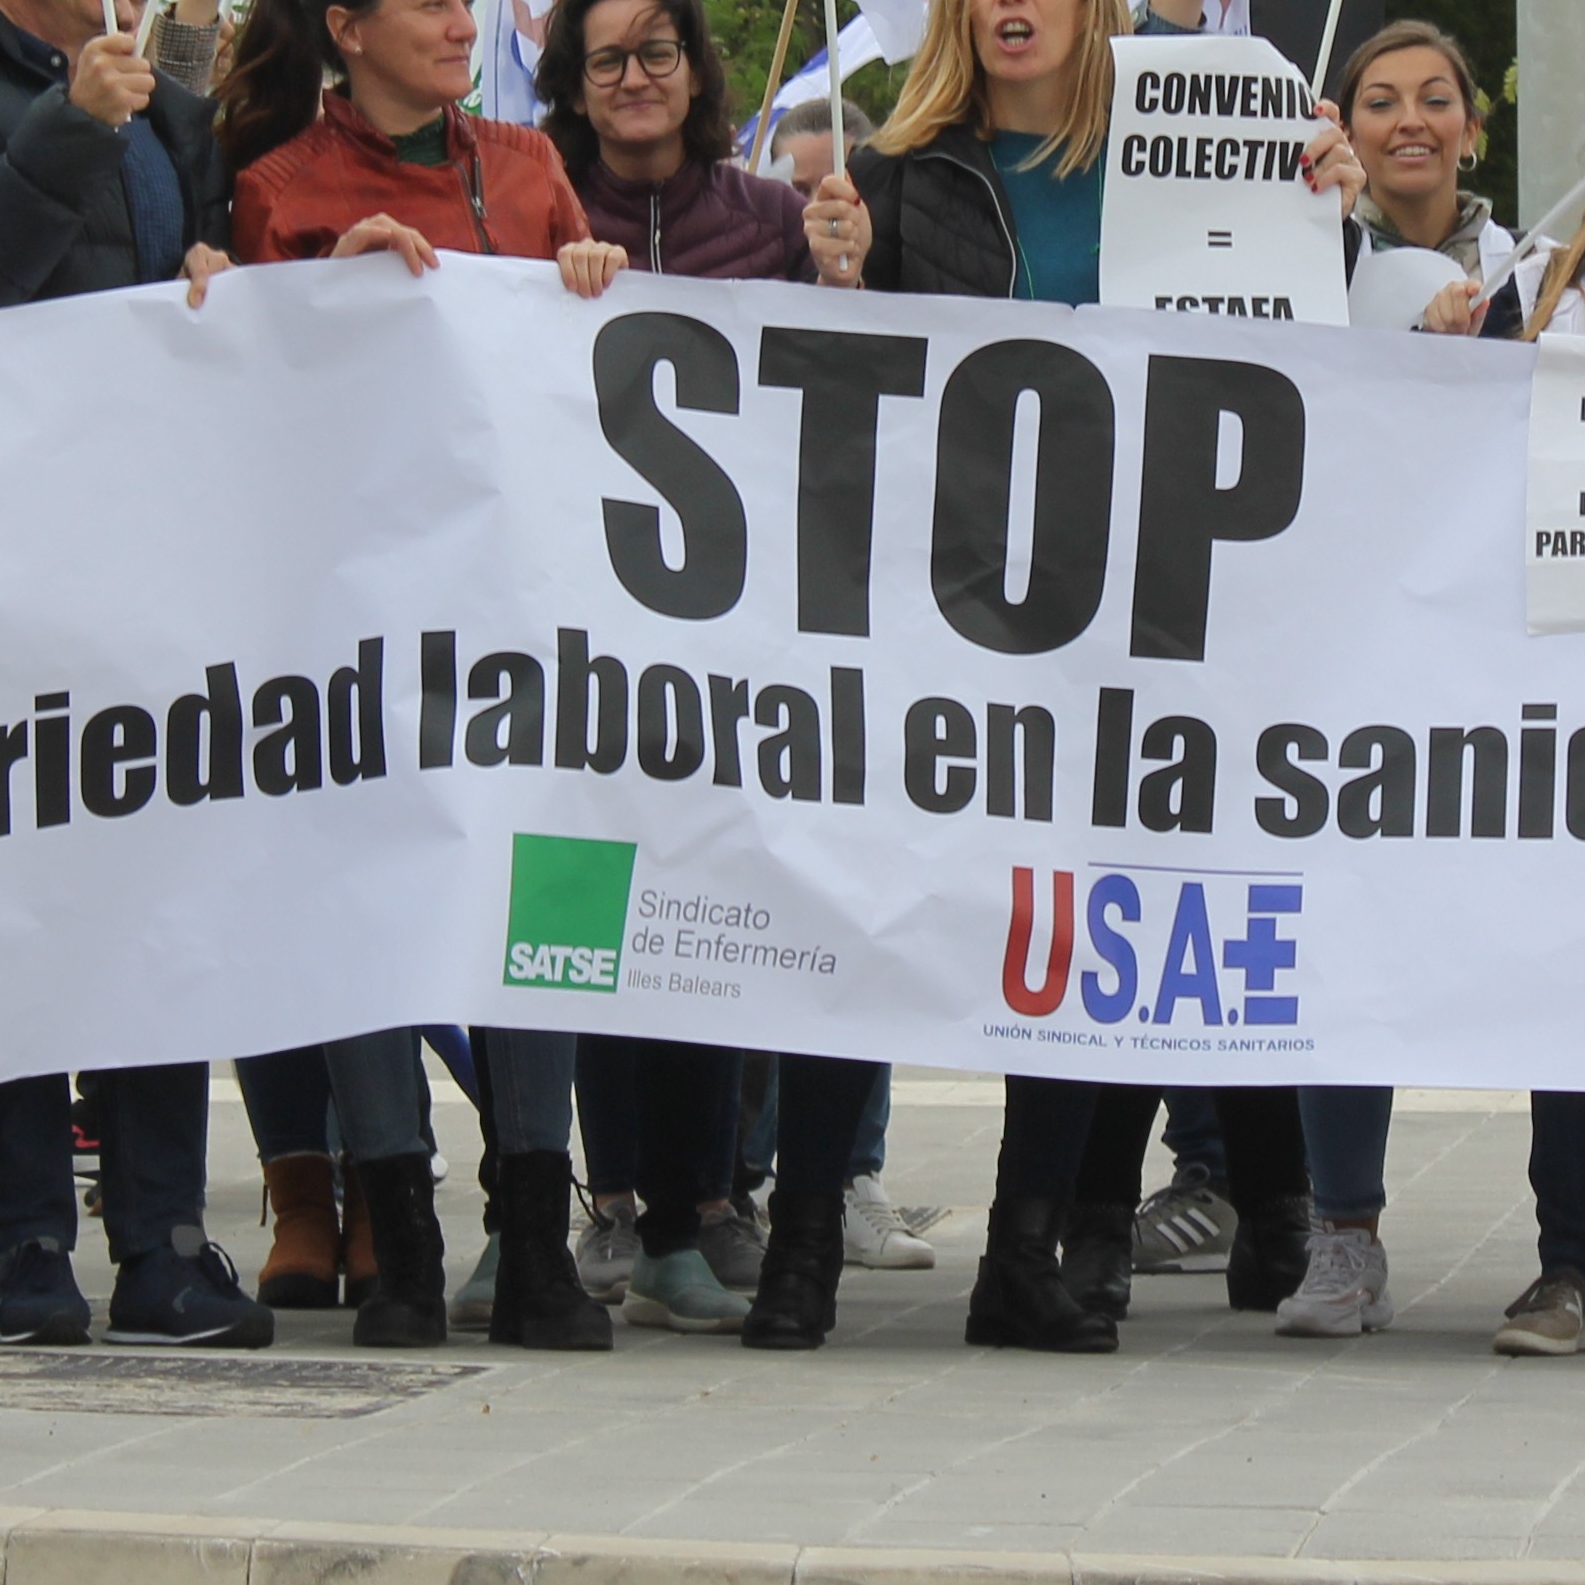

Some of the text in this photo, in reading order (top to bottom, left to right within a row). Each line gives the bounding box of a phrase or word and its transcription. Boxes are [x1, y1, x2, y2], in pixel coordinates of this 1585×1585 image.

[1121, 134, 1313, 181] COLECTIV
[593, 311, 1306, 662] STOP
[420, 629, 866, 806] laboral
[904, 696, 1055, 823] en
[1092, 687, 1217, 833] la
[637, 889, 771, 930] Sindicato
[507, 940, 617, 987] SATSE
[631, 926, 836, 976] de Enfermería
[627, 968, 742, 999] Illes Balears
[983, 1022, 1315, 1053] UNIÓN SINDICAL Y TÉCNICOS SANITARIOS
